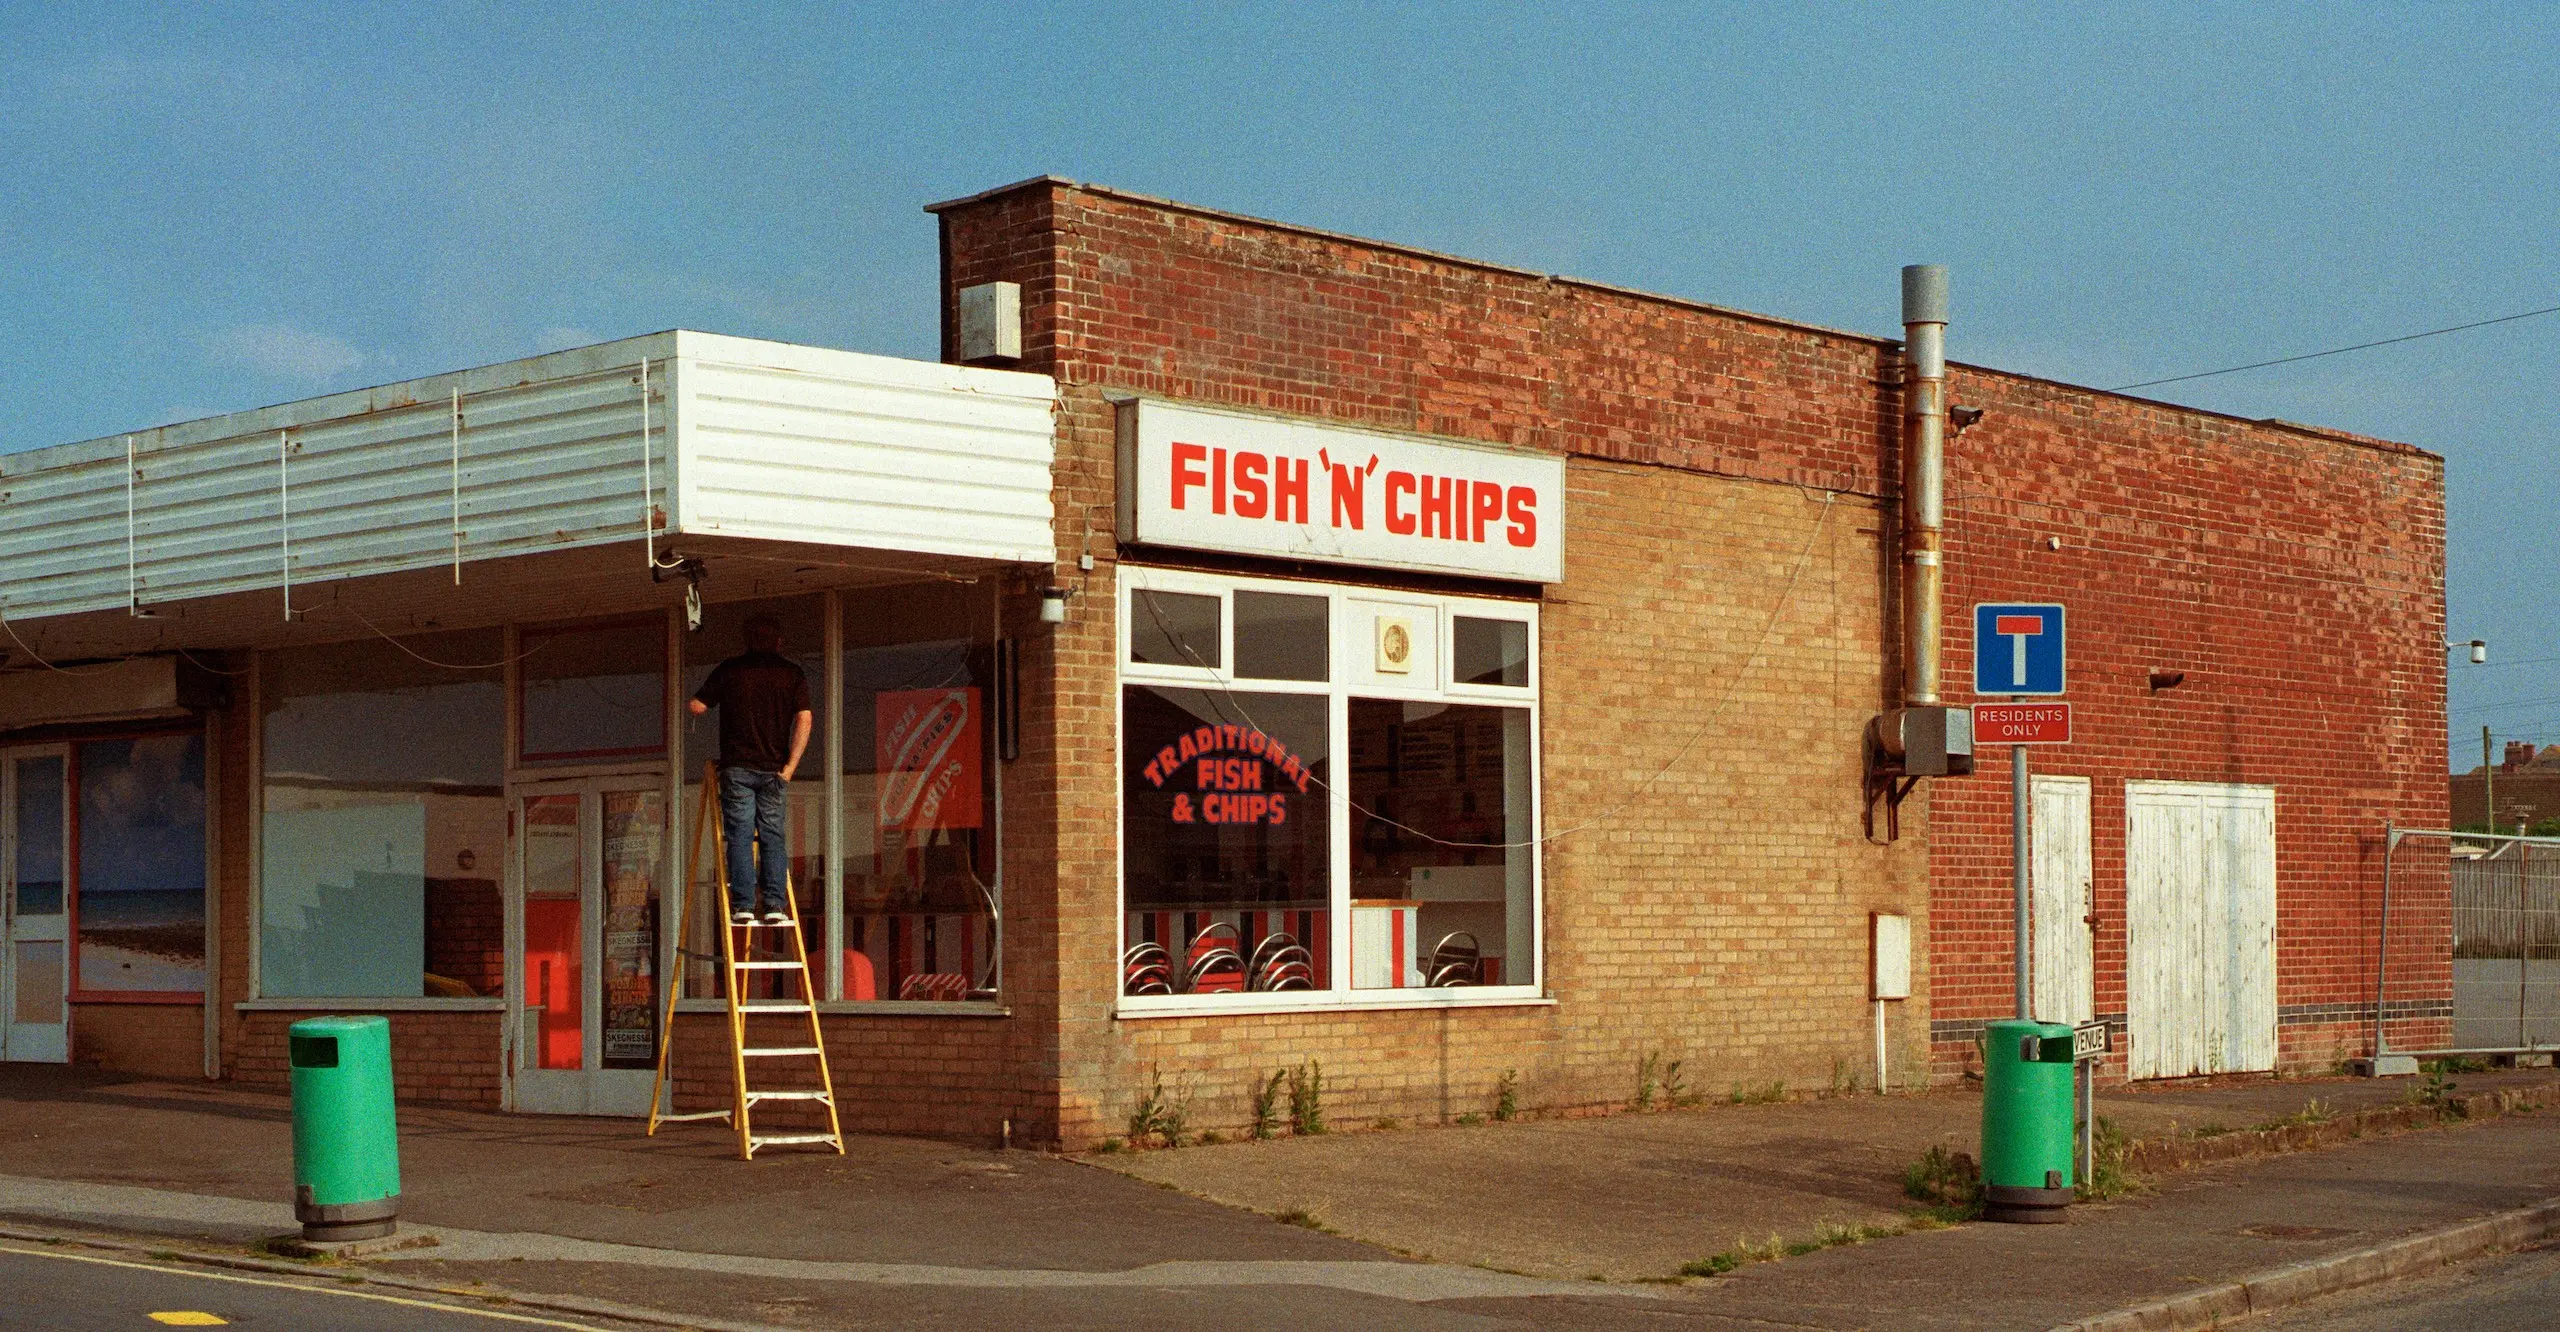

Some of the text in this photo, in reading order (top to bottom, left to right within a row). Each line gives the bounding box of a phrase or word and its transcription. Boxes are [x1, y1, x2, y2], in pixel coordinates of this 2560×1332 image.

[1170, 443, 1537, 549] FISH 'N' CHIPS
[884, 703, 917, 759] FISH
[1979, 709, 2064, 722] RESIDENTS
[2002, 724, 2041, 737] ONLY
[1144, 723, 1311, 793] TRADITIONAL
[1197, 758, 1262, 790] FISH
[921, 760, 963, 818] CHIPS
[1172, 793, 1287, 825] & CHIPS
[606, 1033, 645, 1042] SKEGNESS
[2073, 1028, 2103, 1052] VENUE
